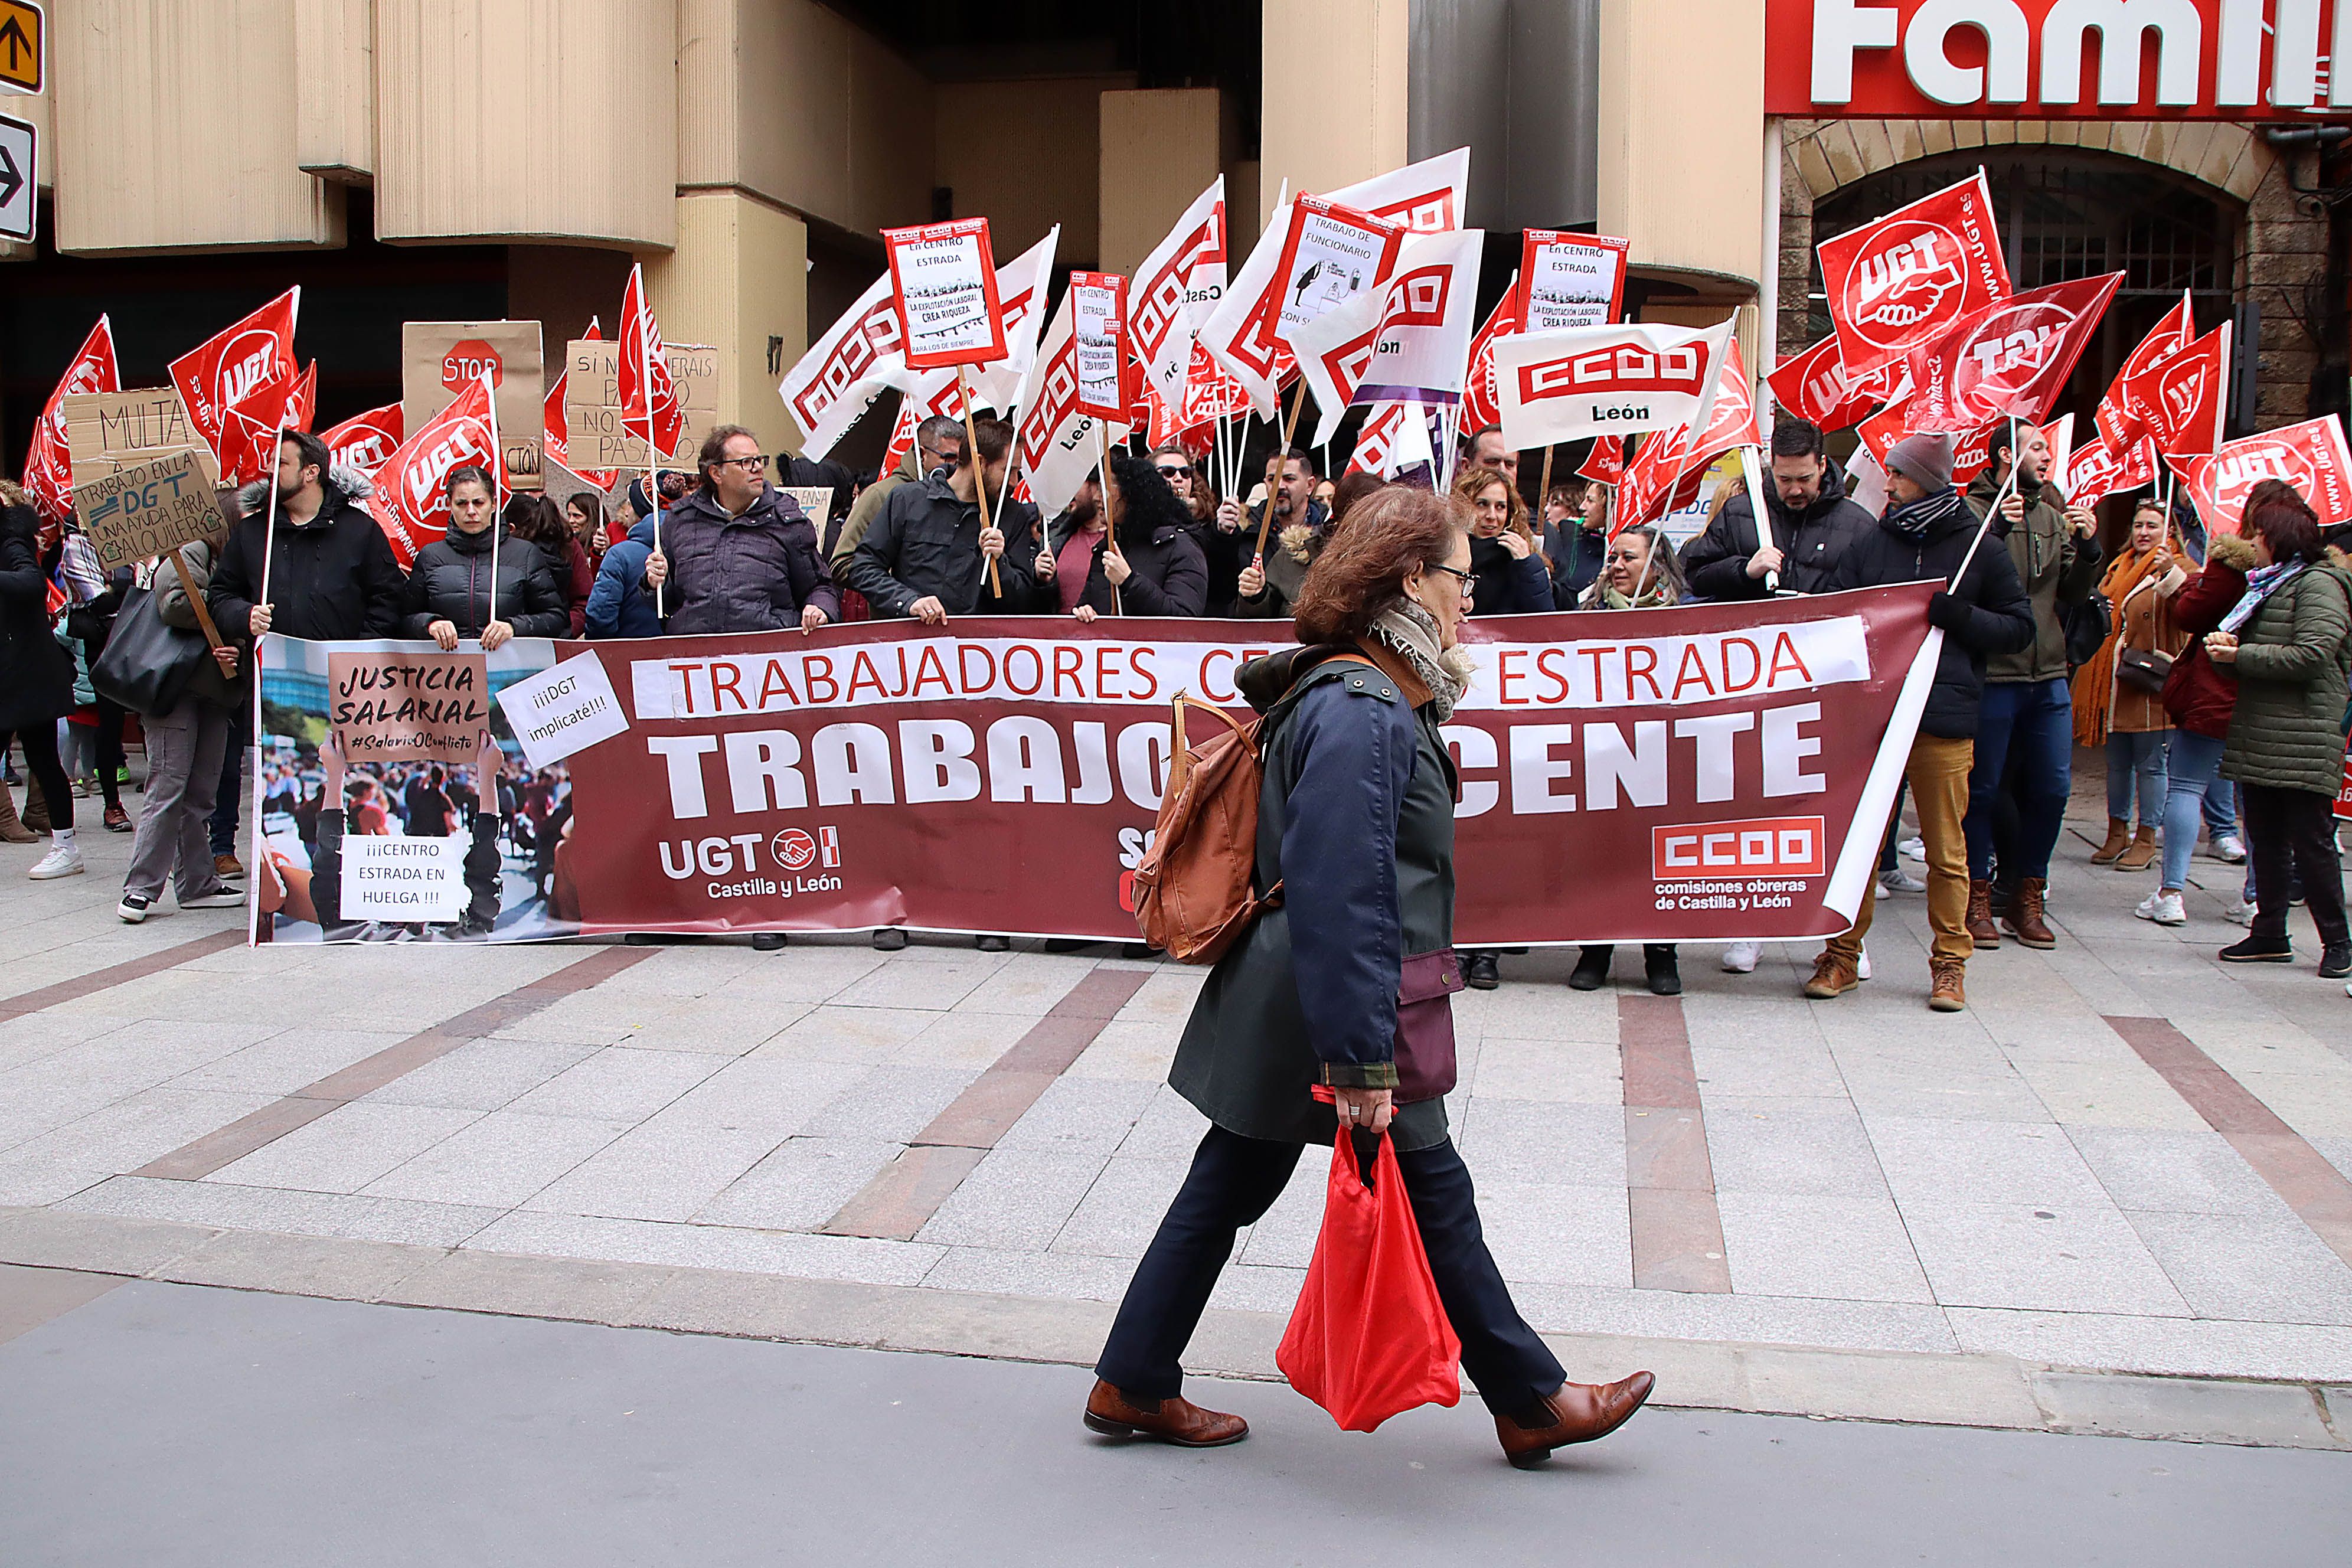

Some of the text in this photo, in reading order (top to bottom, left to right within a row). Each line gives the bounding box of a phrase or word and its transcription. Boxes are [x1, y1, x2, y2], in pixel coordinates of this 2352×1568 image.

[1301, 196, 1331, 210] CCOO
[924, 225, 952, 236] CCOO
[953, 221, 982, 230] CCOO
[1315, 218, 1357, 237] TRABAJO
[1357, 231, 1371, 243] DE
[1366, 215, 1396, 228] CCOO
[892, 230, 920, 239] CCOO
[909, 242, 921, 251] En
[924, 237, 963, 249] CENTRO
[1305, 232, 1371, 259] FUNCIONARIO
[1600, 237, 1628, 245] CCOO
[916, 254, 962, 267] ESTRADA
[1549, 244, 1560, 253] En
[1564, 246, 1603, 257] CENTRO
[1552, 262, 1597, 274] ESTRADA
[1860, 230, 1941, 301] UGT
[919, 297, 953, 311] EXPLOTACIÓN
[954, 292, 978, 305] LABORAL
[1080, 288, 1109, 299] En CENTRO
[922, 305, 971, 323] CREA RIQUEZA
[1083, 305, 1107, 316] ESTRADA
[1280, 311, 1311, 326] CON S
[1541, 305, 1577, 316] EXPLOTACIÓN
[1577, 308, 1602, 316] LABORAL
[1543, 318, 1560, 327] CREA
[950, 339, 975, 348] SIEMPRE
[223, 340, 274, 409] UGT
[443, 357, 497, 383] STOP
[1531, 346, 1697, 393] CCOO
[100, 399, 189, 451] MULTA
[584, 411, 614, 433] NO
[1592, 403, 1649, 422] León
[1060, 414, 1093, 452] Leó
[331, 435, 383, 469] UGT
[408, 422, 481, 502] UGT
[73, 453, 194, 505] TRABAJO EN LA
[2066, 449, 2113, 505] UGT
[2213, 446, 2293, 489] UGT
[2308, 426, 2343, 515] www.UGT.es
[124, 472, 189, 515] DGT
[95, 491, 208, 541] UNA AYUDA PARA
[1685, 498, 1712, 515] DG
[378, 486, 419, 561] www.ugt.es
[122, 517, 203, 560] ALQUILER
[668, 643, 1158, 714] TRABAJADORES
[1498, 632, 1813, 705] ESTRADA
[339, 665, 474, 698] JUSTICIA
[334, 697, 488, 726] SALARIAL
[527, 695, 608, 743] implicaté!!!
[647, 715, 1190, 819] TRABAJO
[1437, 701, 1827, 819] CENTE
[658, 832, 763, 880] UGT
[1665, 830, 1813, 868] CCOO
[360, 867, 445, 880] ESTRADA EN
[708, 874, 842, 898] Castilla y León
[362, 891, 439, 904] HUELGA !!!
[1655, 879, 1807, 894] comisiones obreras
[1655, 893, 1792, 911] de Castilla y León
